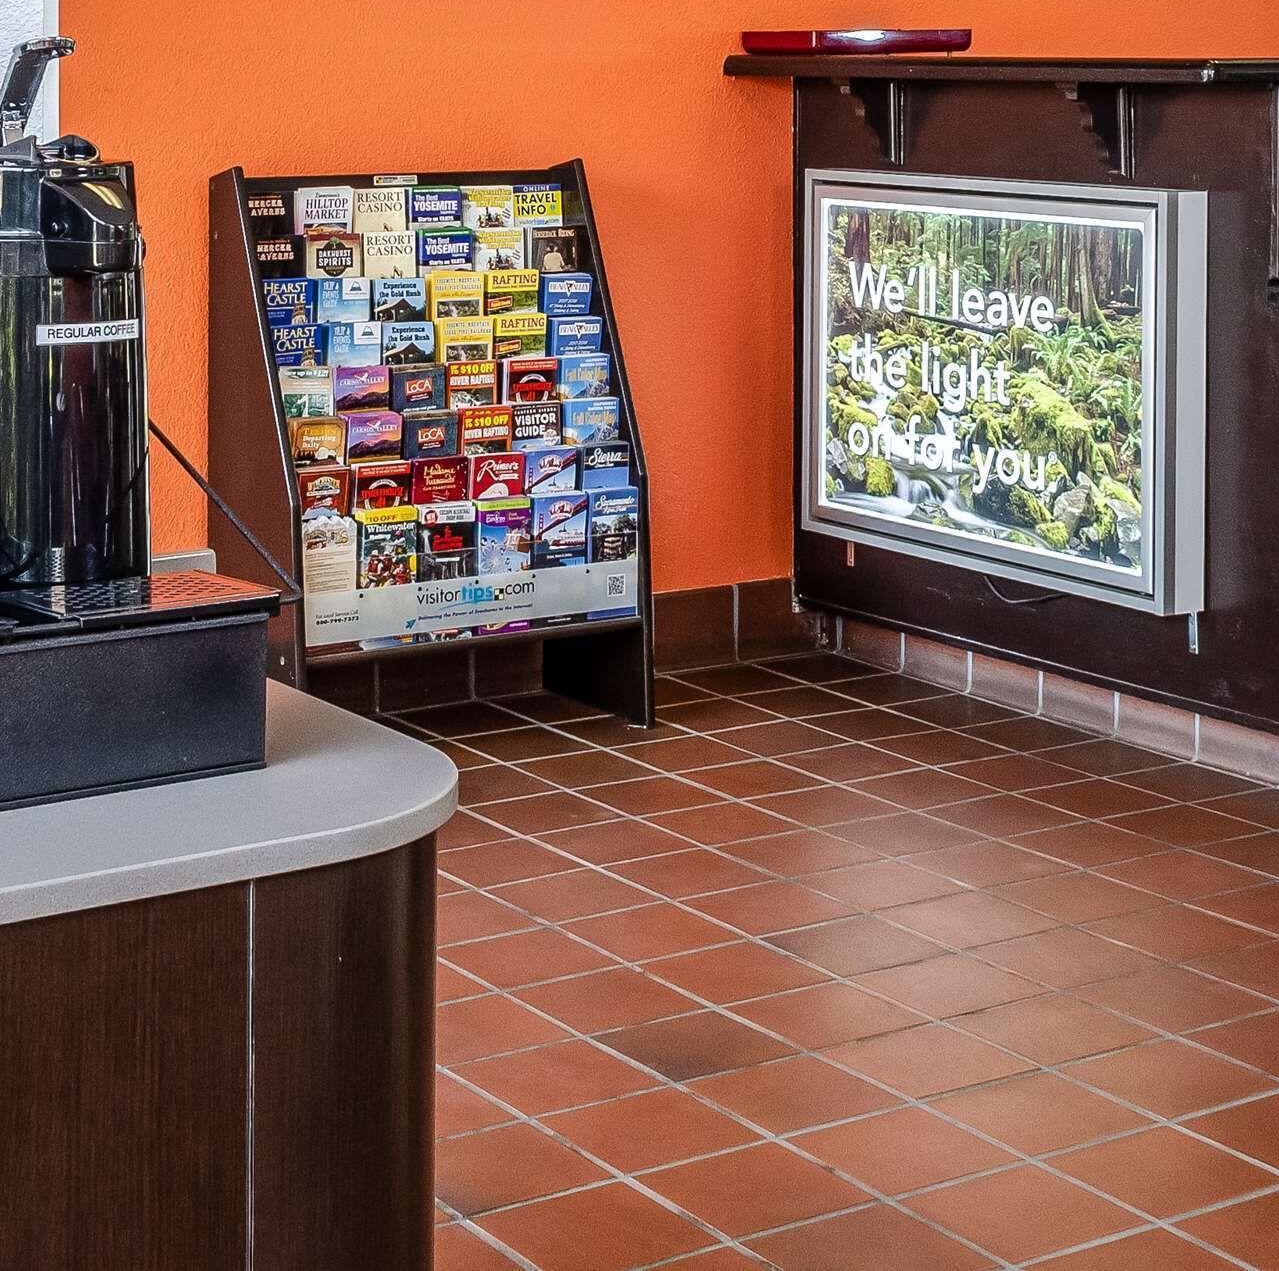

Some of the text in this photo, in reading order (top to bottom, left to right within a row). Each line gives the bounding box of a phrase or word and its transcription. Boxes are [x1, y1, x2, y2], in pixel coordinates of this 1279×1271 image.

[357, 191, 402, 203] RESORT
[515, 193, 556, 204] TRAVEL
[306, 198, 349, 209] HILLTOP
[357, 202, 402, 213] CASINO
[413, 201, 458, 211] YOSEMITE
[305, 209, 348, 220] MARKET
[517, 205, 546, 216] INFO
[366, 234, 413, 246] RESORT
[318, 249, 351, 258] OAKHURST
[367, 245, 413, 257] CASINO
[425, 243, 469, 255] YOSEMITE
[318, 257, 351, 266] SPIRITS
[493, 273, 537, 285] RAFTING
[264, 281, 308, 295] HEARST
[391, 290, 405, 298] Gold
[267, 293, 307, 306] CASTLE
[848, 261, 1055, 332] We'll leave
[501, 317, 545, 328] RAFTING
[47, 323, 135, 339] REGULAR COFFEE
[273, 326, 318, 340] HEARST
[276, 338, 315, 351] CASTLE
[460, 364, 479, 374] $10
[480, 362, 495, 373] OFF
[848, 333, 1012, 414] the light
[474, 417, 491, 427] $10
[493, 415, 509, 425] OFF
[515, 413, 556, 425] VISITOR
[515, 425, 547, 437] GUIDE
[303, 435, 336, 443] Departing
[847, 422, 892, 460] on
[904, 413, 962, 474] for
[588, 447, 623, 466] Sierra
[380, 514, 396, 522] OFF
[366, 522, 417, 533] Whitewater
